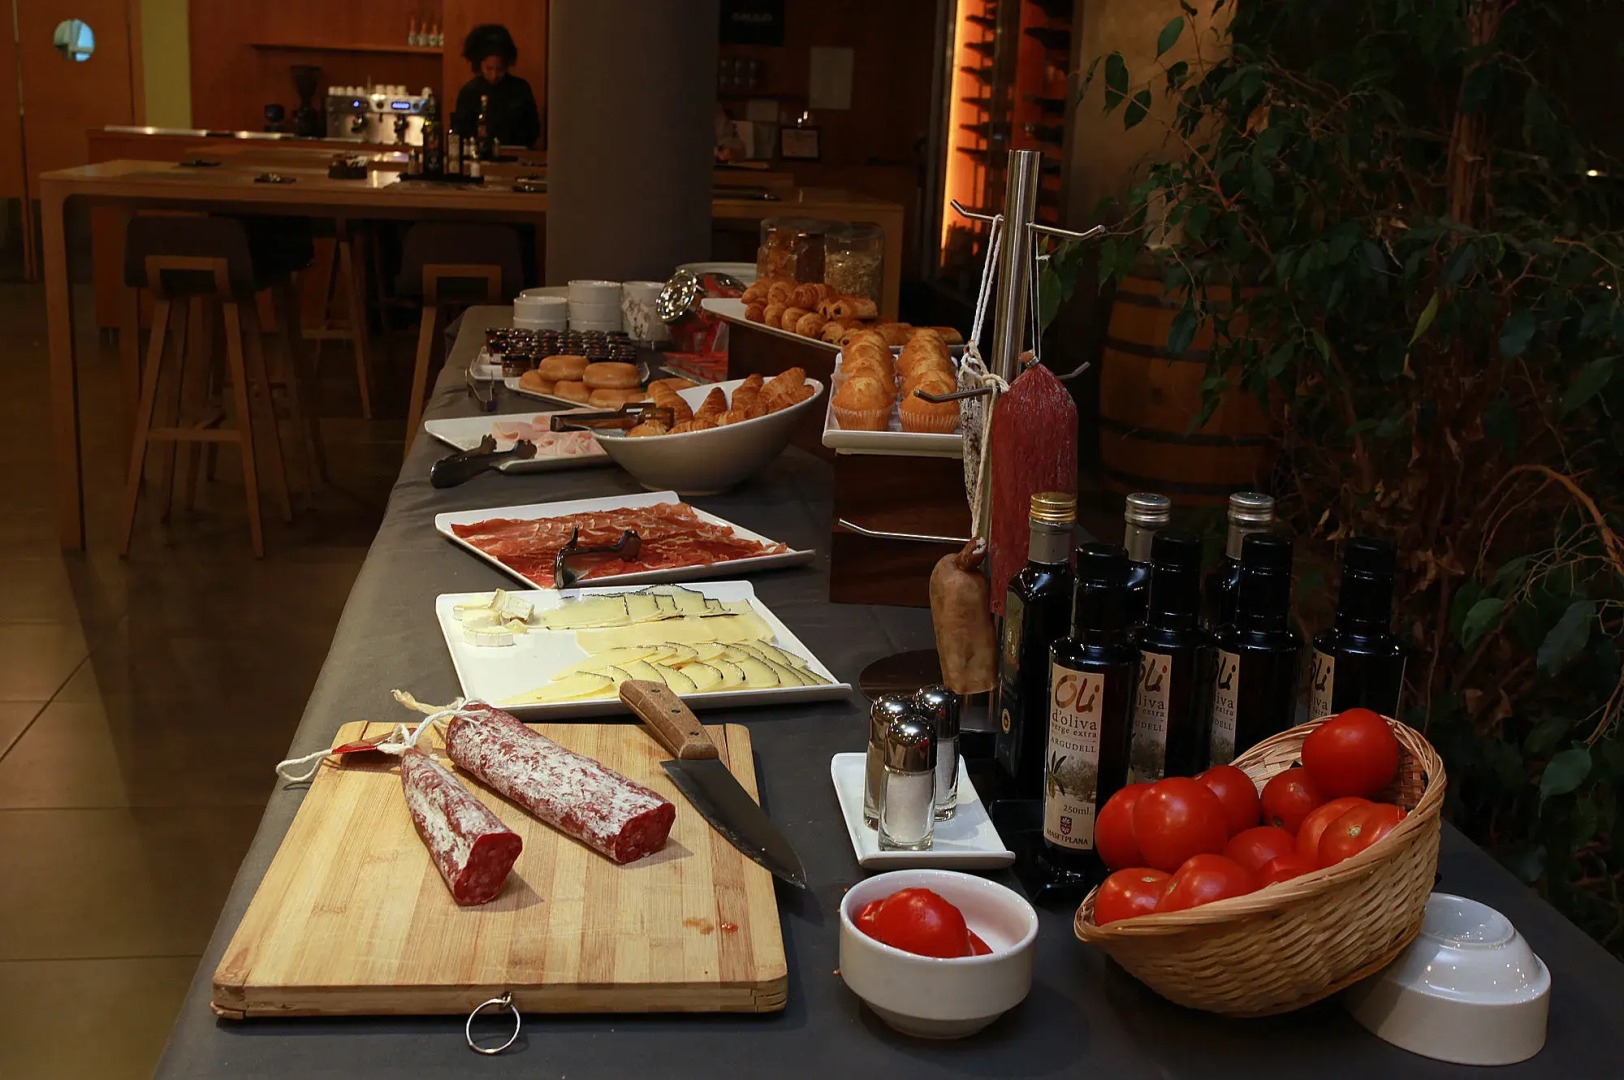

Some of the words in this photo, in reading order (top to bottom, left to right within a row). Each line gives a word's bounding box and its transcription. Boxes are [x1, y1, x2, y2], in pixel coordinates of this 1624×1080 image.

[1214, 655, 1236, 690] li
[1138, 693, 1165, 709] liva
[1213, 690, 1234, 709] liva
[1052, 709, 1097, 731] d'oliva
[1135, 719, 1164, 732] UDELL
[1214, 718, 1233, 731] DELL
[1073, 730, 1097, 738] extra
[1051, 736, 1096, 753] ARGUDELL
